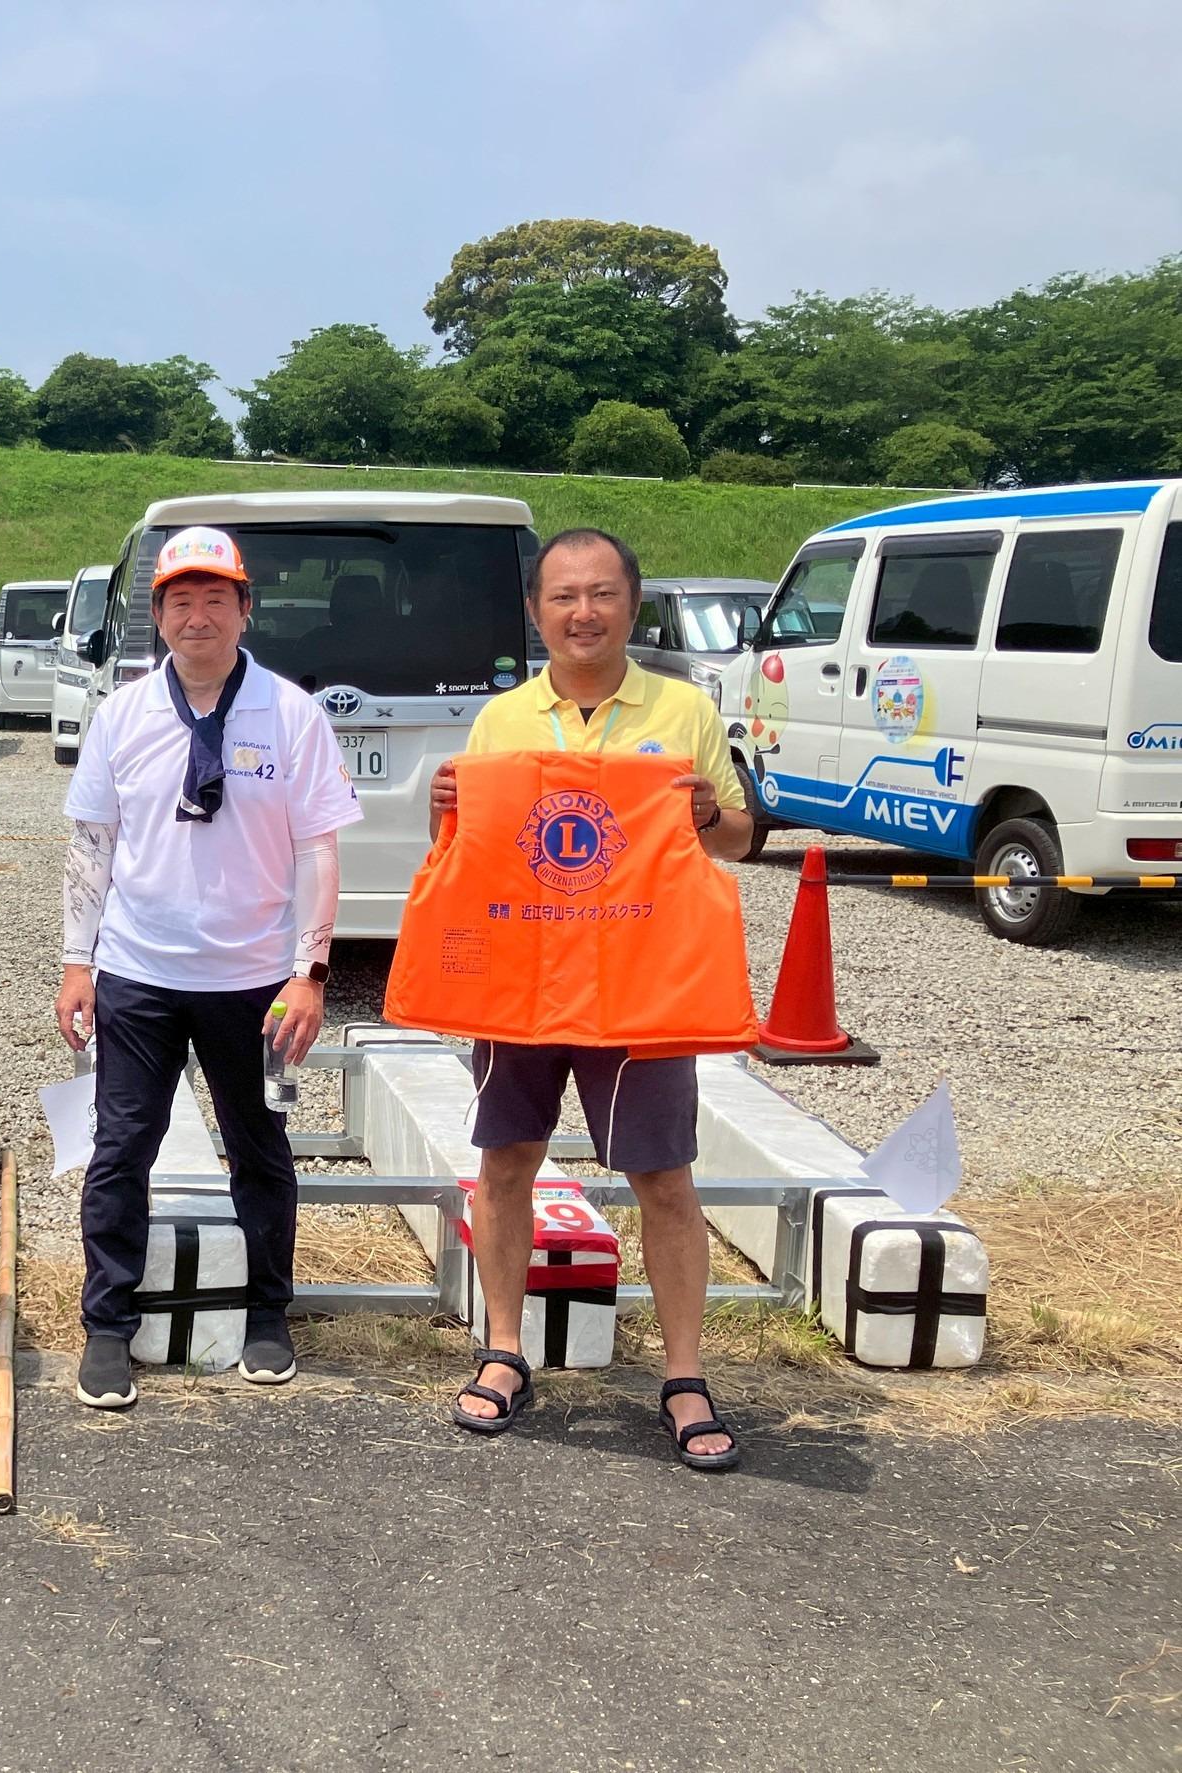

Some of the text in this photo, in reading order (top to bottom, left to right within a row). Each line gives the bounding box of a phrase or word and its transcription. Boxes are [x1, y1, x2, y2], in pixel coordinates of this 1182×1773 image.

[470, 682, 489, 693] peak
[342, 736, 366, 748] 337
[1145, 736, 1182, 749] Mi
[254, 763, 275, 780] 42
[539, 795, 603, 816] LIONS
[864, 795, 957, 835] MiEV
[559, 822, 588, 858] L
[540, 867, 602, 887] INTERNATIONAL
[488, 903, 654, 921] 寄贈 近江守山ライオンズクラブ
